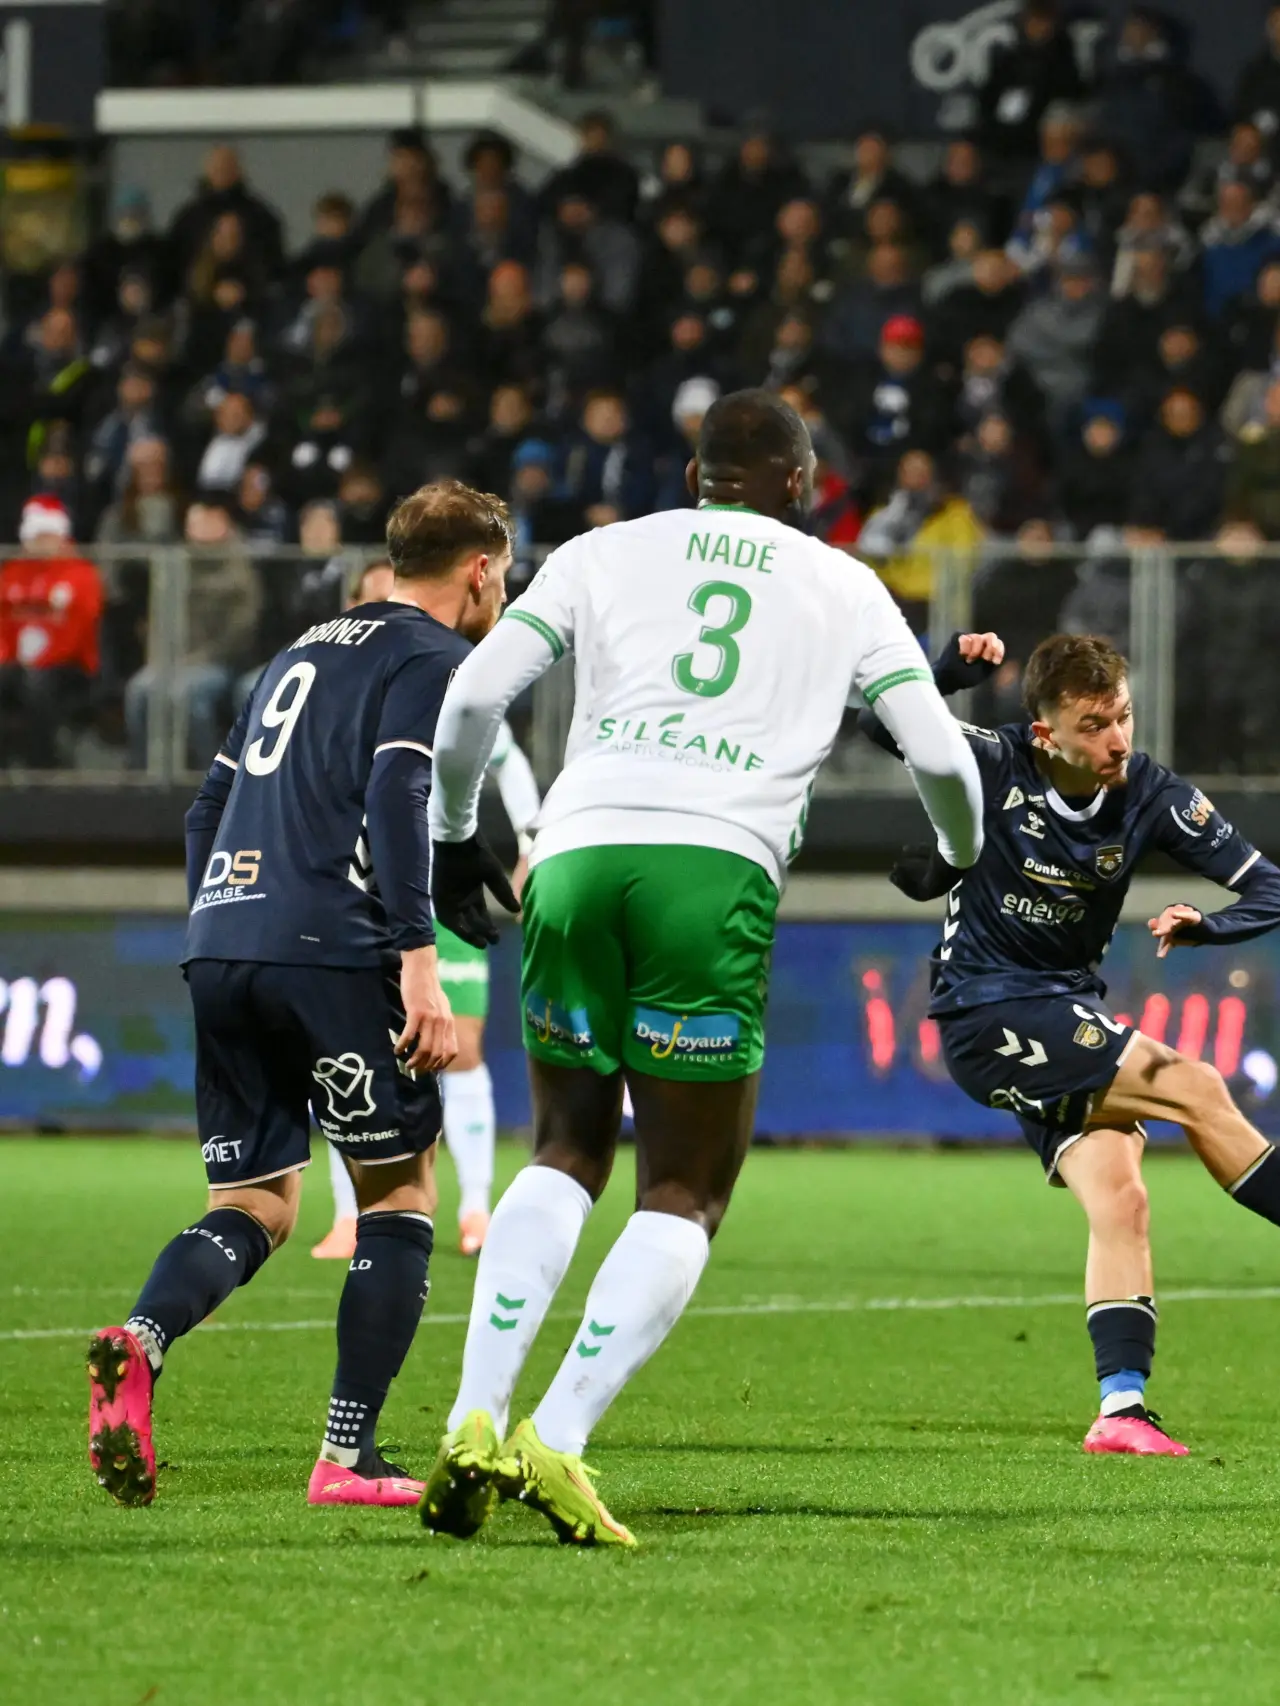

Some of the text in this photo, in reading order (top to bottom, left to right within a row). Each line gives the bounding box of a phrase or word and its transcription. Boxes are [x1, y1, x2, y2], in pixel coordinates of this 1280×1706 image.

[670, 579, 752, 698] 3
[244, 661, 317, 776] 9
[203, 849, 262, 888] DS
